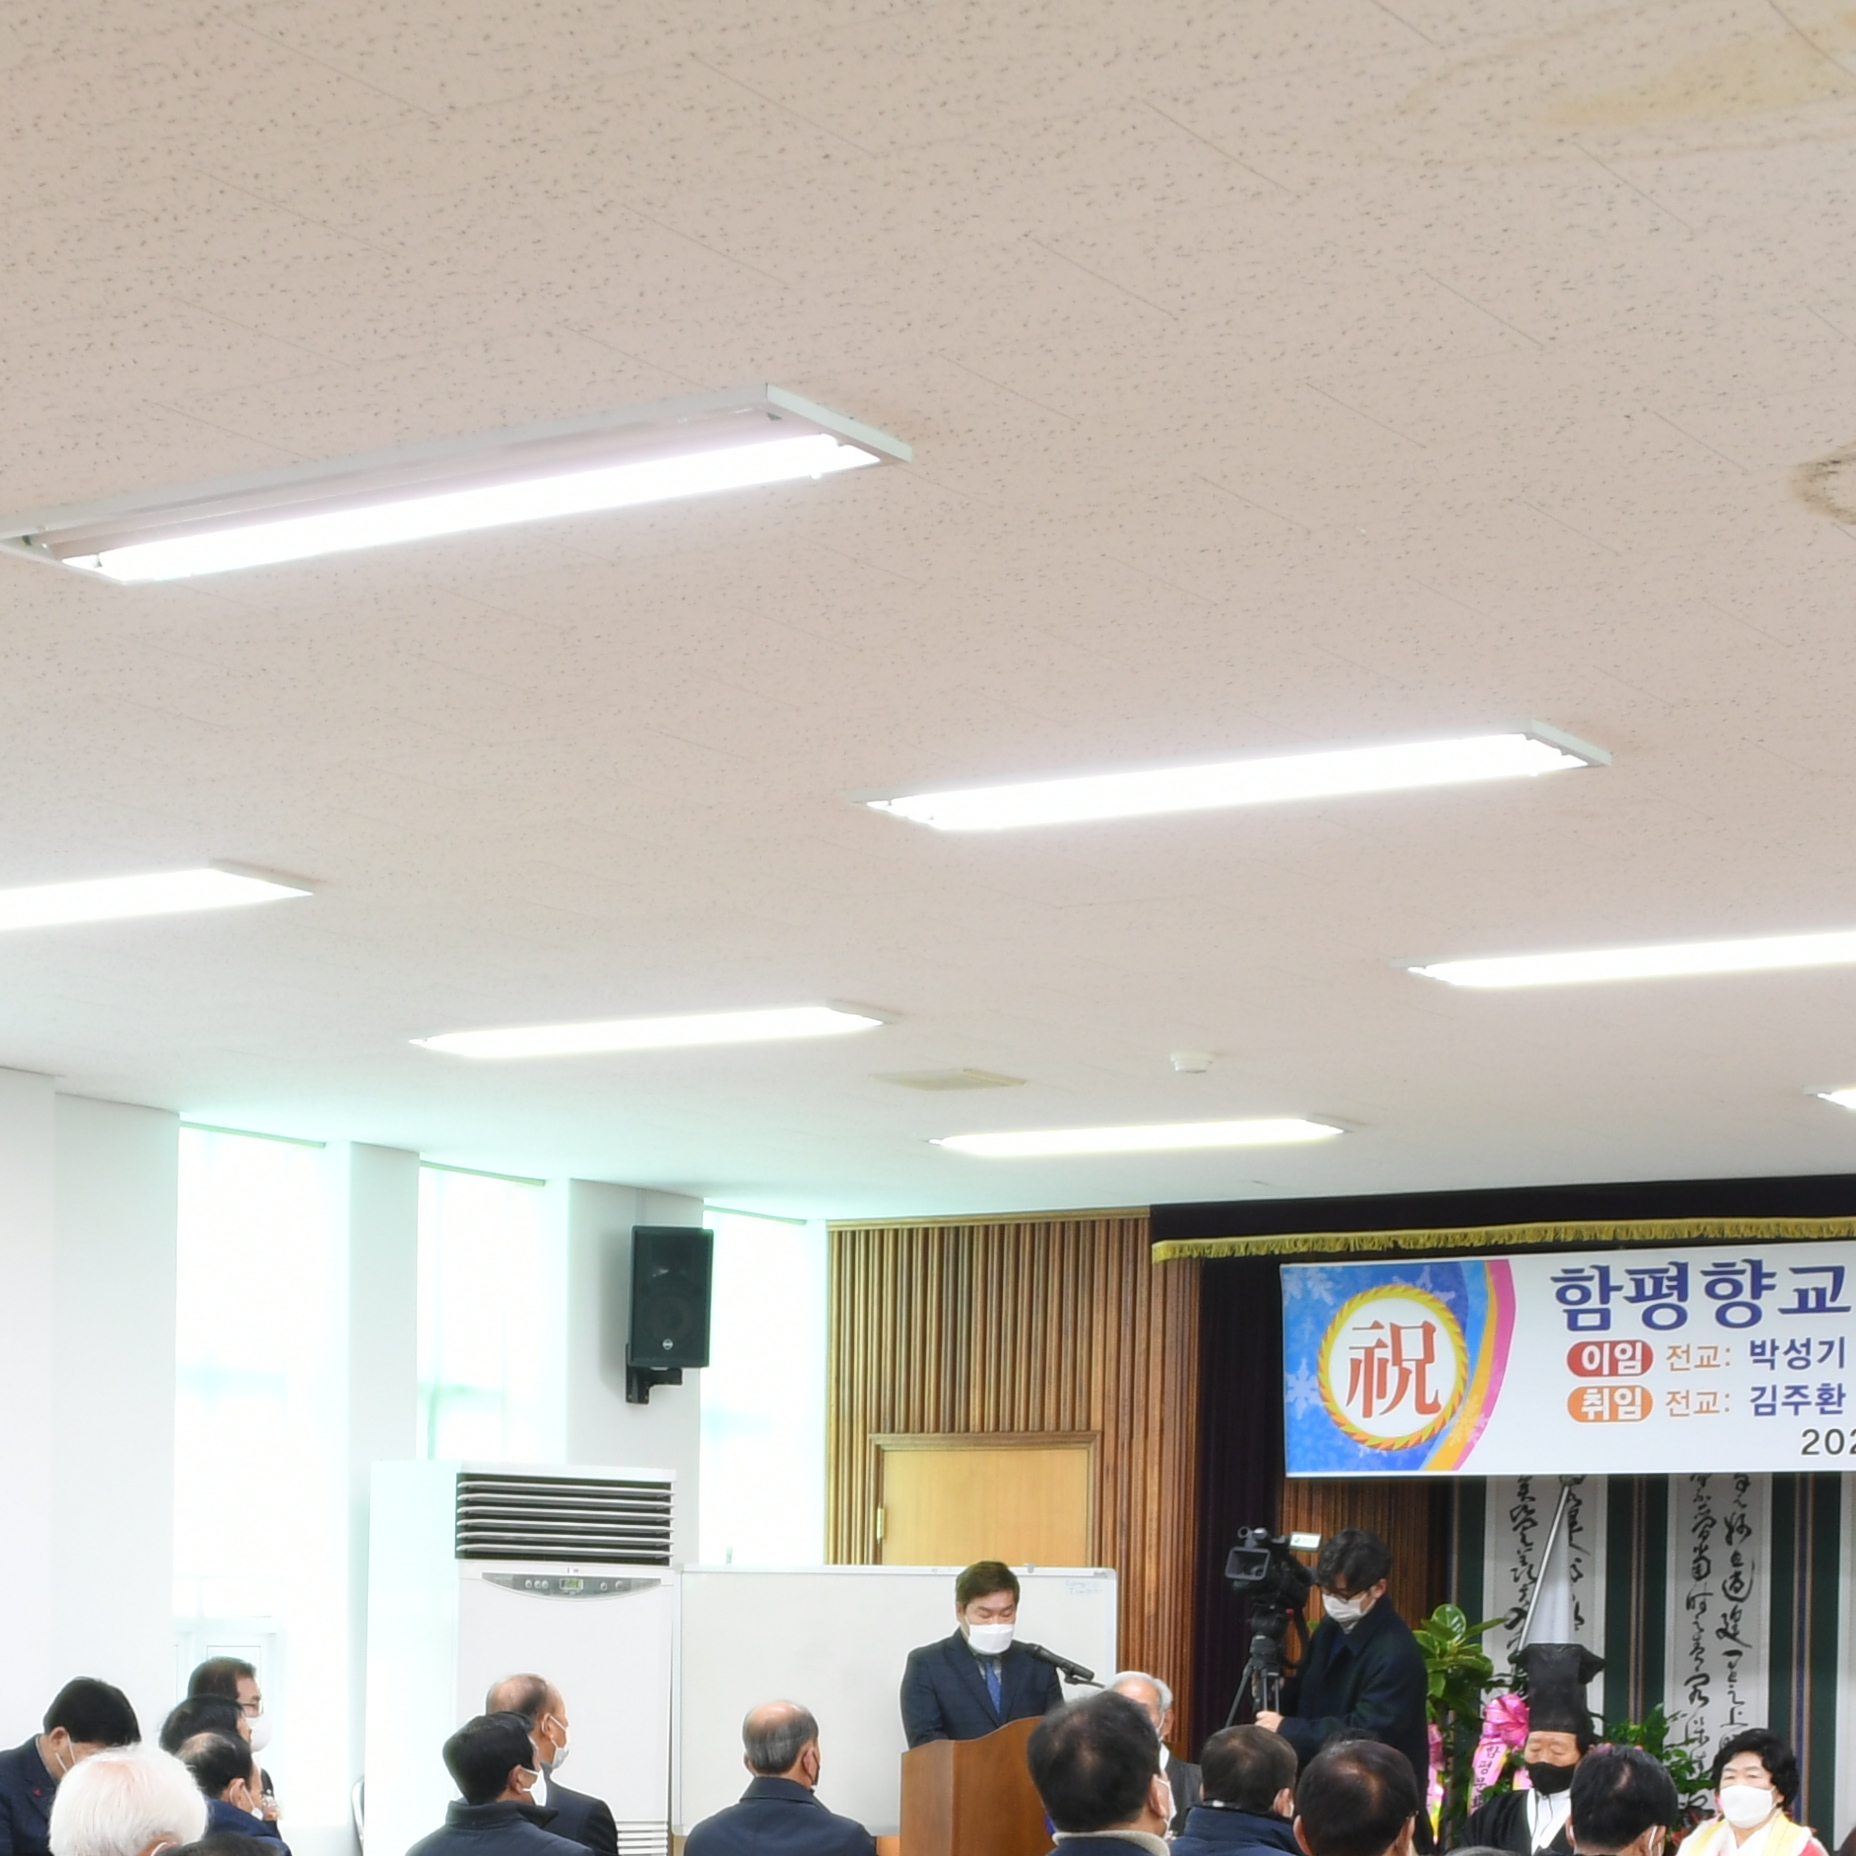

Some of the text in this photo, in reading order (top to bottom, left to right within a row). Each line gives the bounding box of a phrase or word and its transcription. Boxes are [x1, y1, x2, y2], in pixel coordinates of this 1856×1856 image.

[1550, 1258, 1852, 1331] 함평향교
[1345, 1319, 1442, 1419] 祝
[1581, 1342, 1642, 1376] 이임
[1666, 1344, 1732, 1373] 전교:
[1749, 1337, 1846, 1371] 박성기
[1581, 1387, 1642, 1420] 취임
[1665, 1389, 1731, 1418] 전교:
[1749, 1383, 1847, 1417] 김주환
